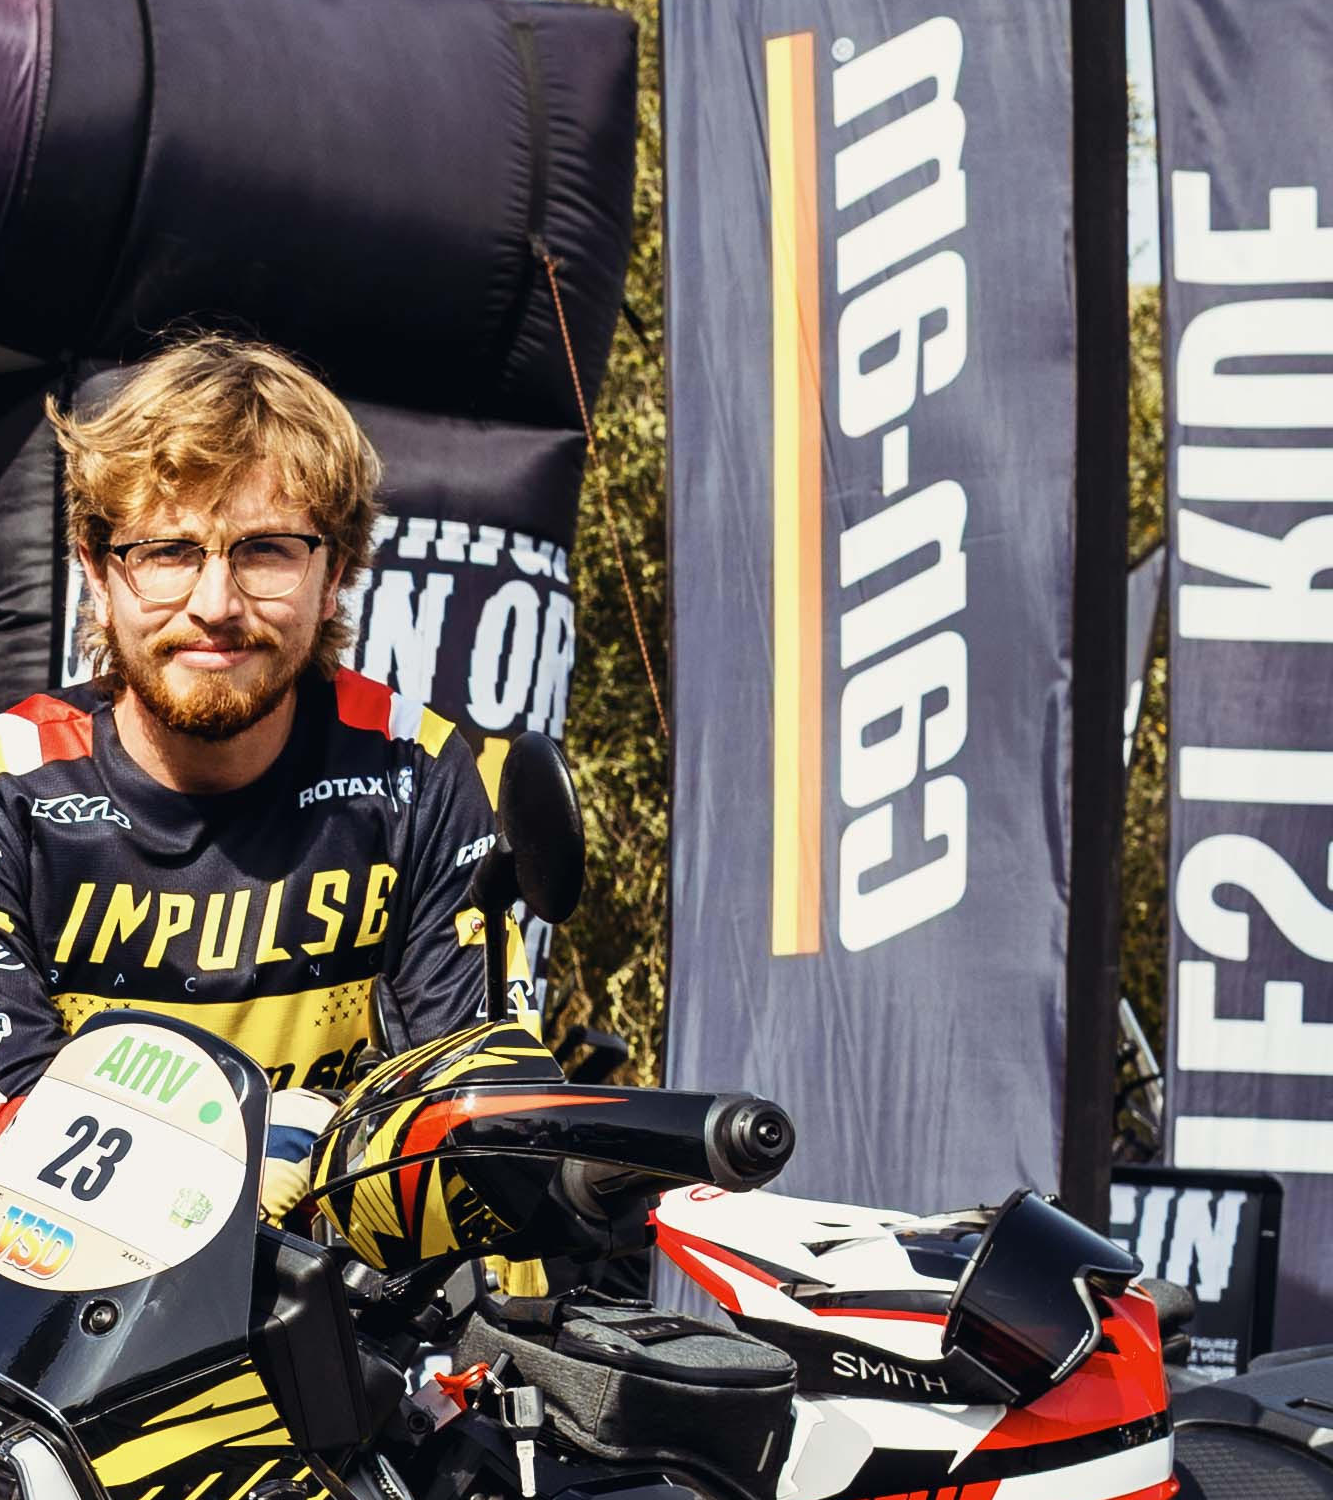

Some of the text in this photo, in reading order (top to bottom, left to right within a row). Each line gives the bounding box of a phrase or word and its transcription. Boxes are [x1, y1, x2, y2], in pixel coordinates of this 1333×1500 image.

[299, 776, 387, 809] ROTAX
[54, 863, 398, 972] IMPULSE
[93, 1035, 202, 1104] AMV
[36, 1115, 134, 1202] 23
[832, 1350, 949, 1397] SMITH
